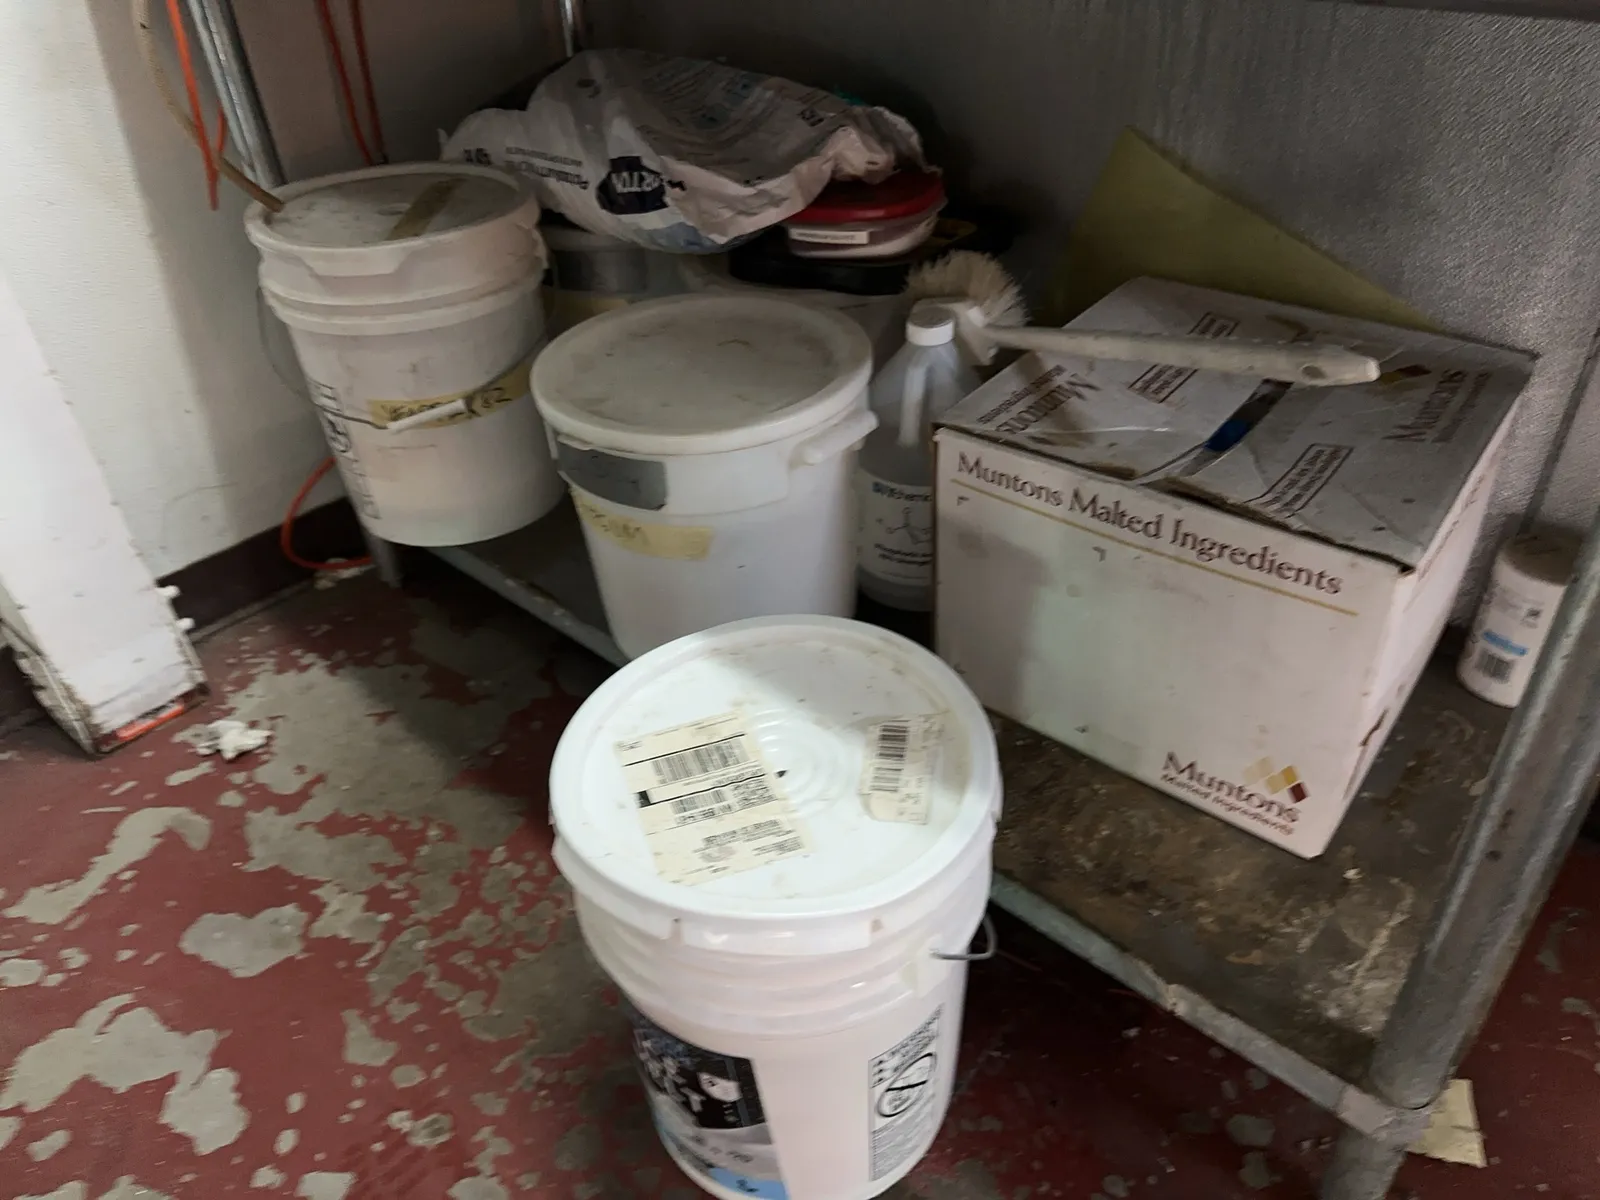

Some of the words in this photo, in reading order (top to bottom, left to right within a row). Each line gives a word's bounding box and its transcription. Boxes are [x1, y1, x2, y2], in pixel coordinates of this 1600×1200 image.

[957, 452, 1062, 507] Muntons
[1069, 486, 1163, 541] Malted
[1170, 522, 1344, 595] Ingredients
[1162, 751, 1302, 823] Muntons
